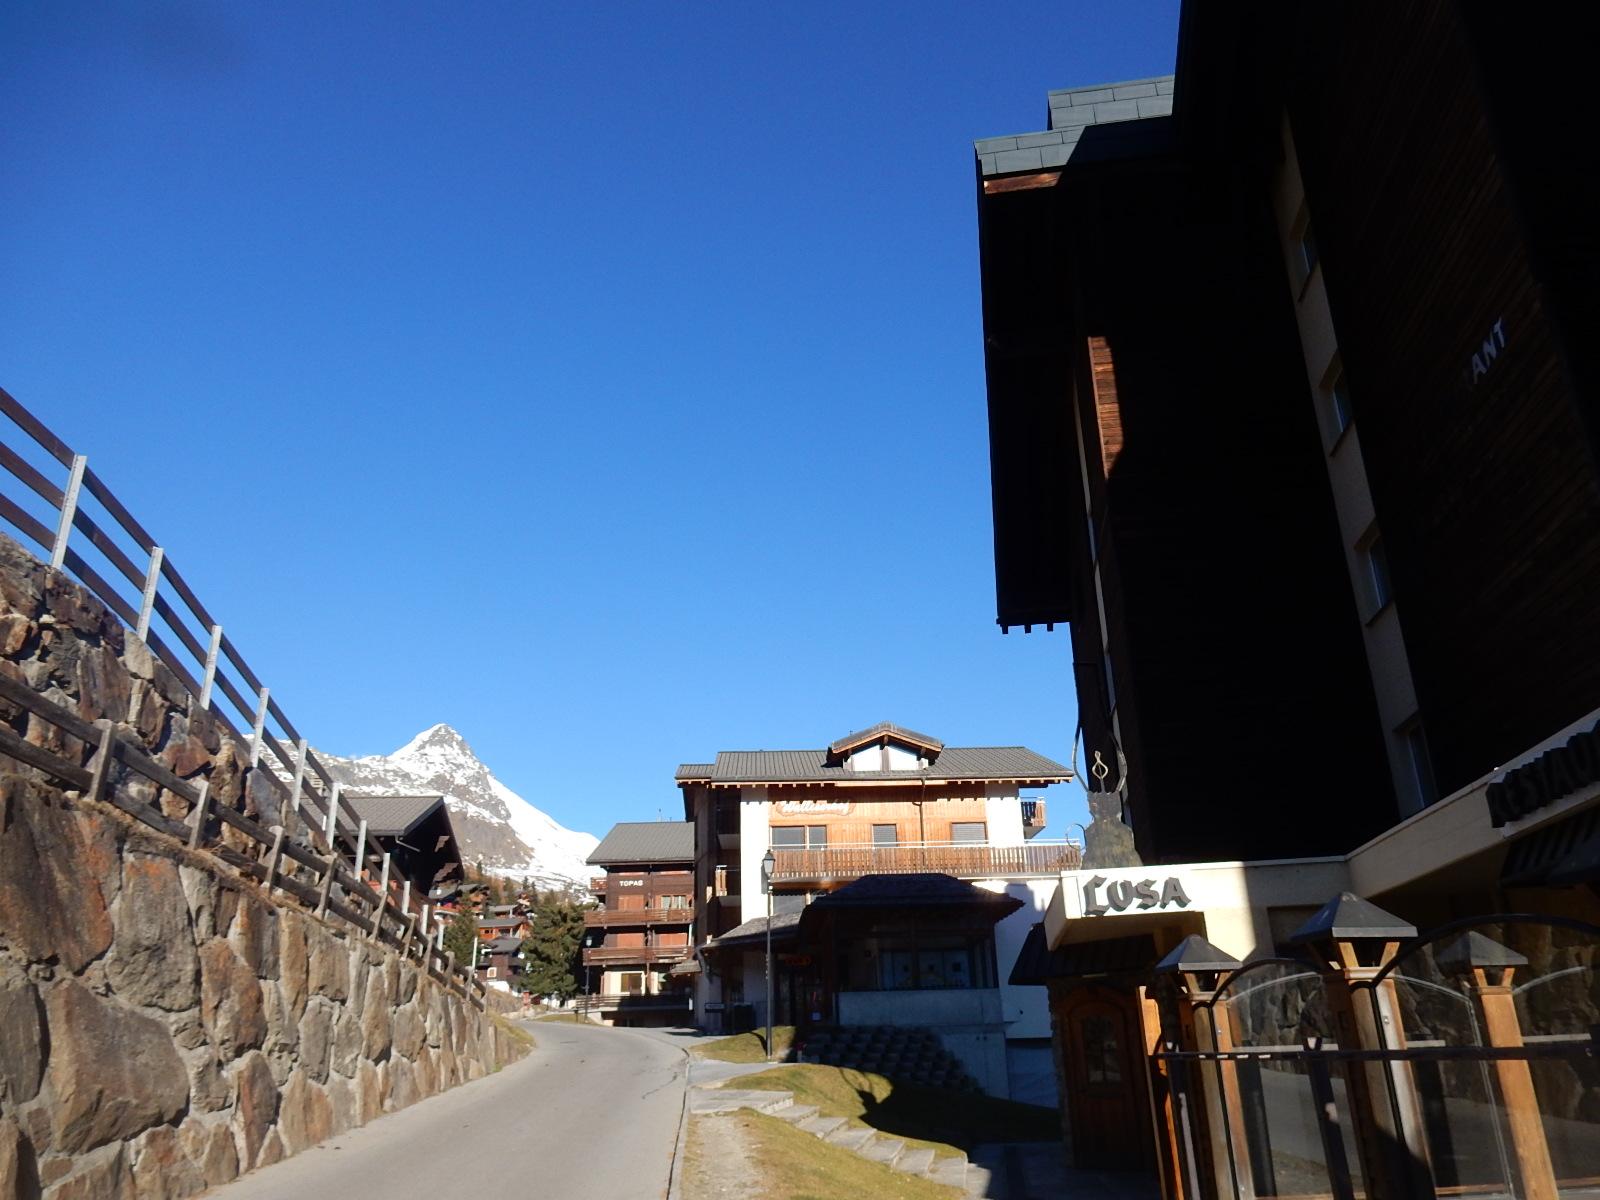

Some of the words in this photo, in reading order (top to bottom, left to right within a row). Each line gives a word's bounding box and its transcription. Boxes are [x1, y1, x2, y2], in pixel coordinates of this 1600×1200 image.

[1471, 319, 1506, 378] ANT
[1486, 717, 1600, 828] RESTAU
[618, 879, 645, 887] TOPAS
